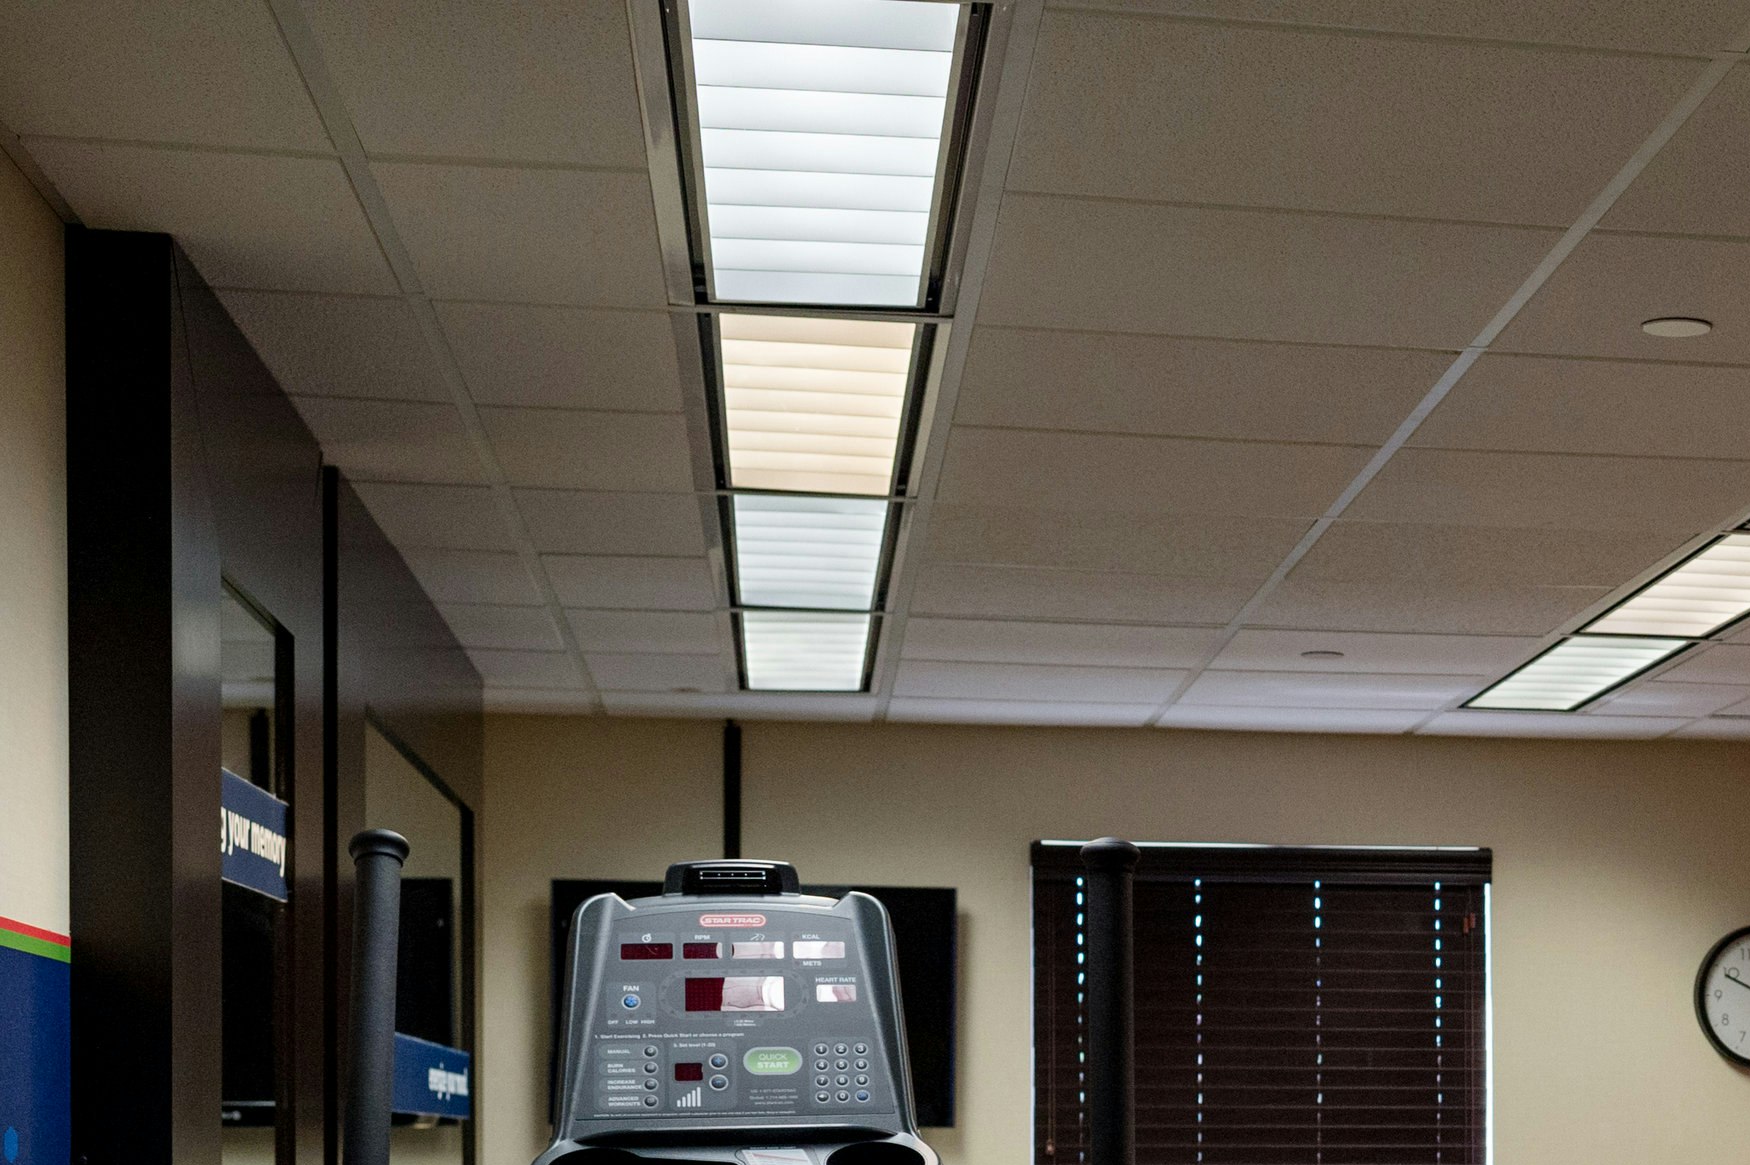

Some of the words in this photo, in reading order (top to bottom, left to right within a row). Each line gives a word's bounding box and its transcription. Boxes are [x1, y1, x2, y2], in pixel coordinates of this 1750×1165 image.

[228, 810, 250, 856] your
[251, 822, 286, 878] memory
[1723, 966, 1740, 979] 10
[1714, 990, 1722, 1001] 9
[1721, 1014, 1729, 1026] 8
[1739, 1031, 1746, 1043] 7
[758, 1053, 788, 1061] QUICK
[756, 1061, 789, 1069] START
